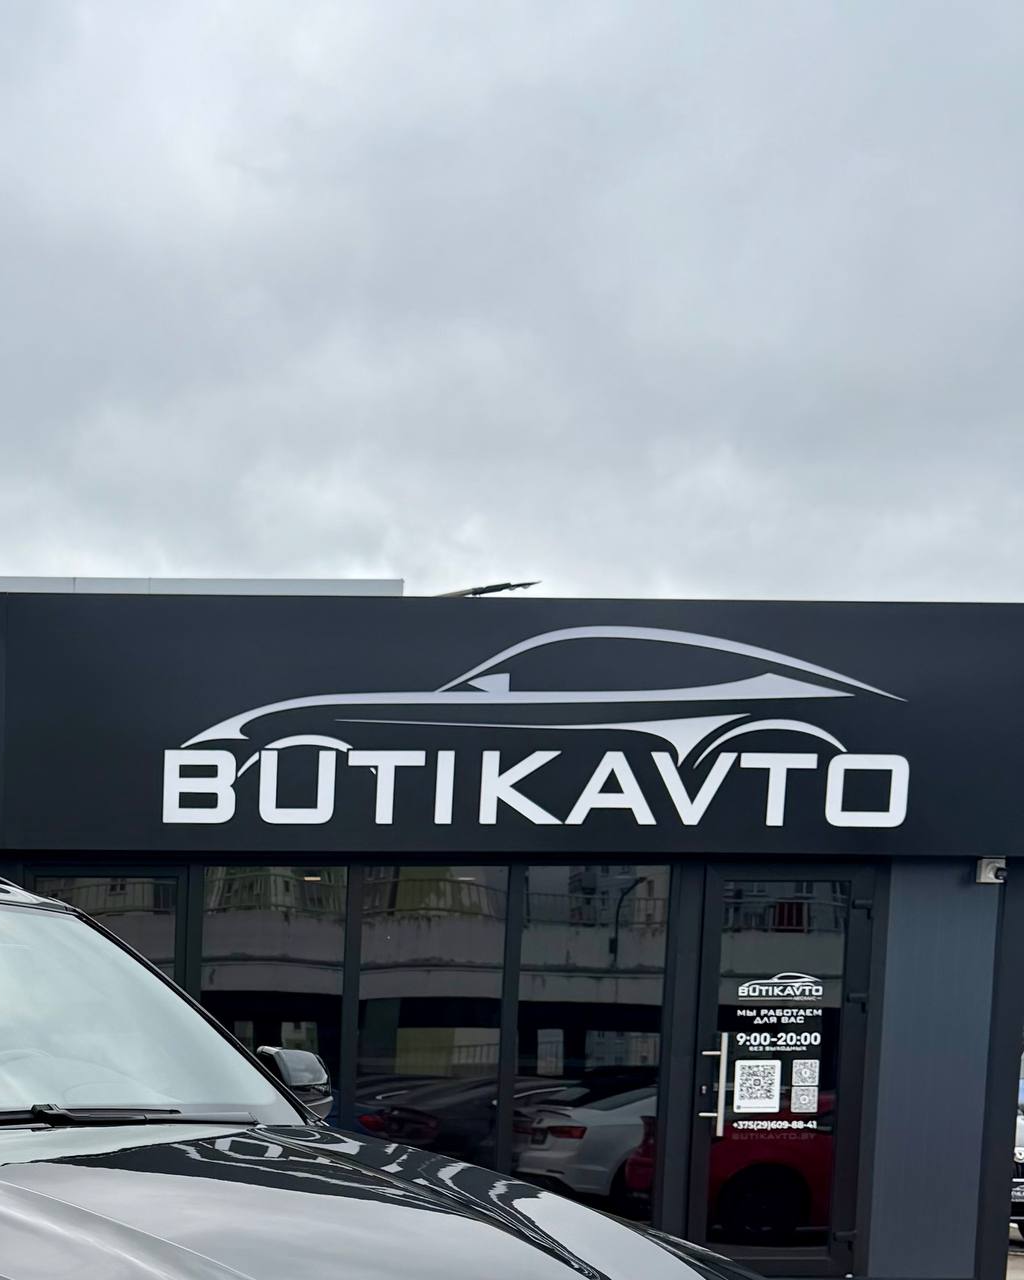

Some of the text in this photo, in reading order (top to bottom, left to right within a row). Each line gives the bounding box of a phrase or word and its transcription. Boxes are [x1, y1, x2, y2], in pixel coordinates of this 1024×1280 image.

[161, 747, 910, 829] BUTIKAVTO
[738, 985, 823, 997] BUTIKAVTO
[737, 1009, 823, 1017] МЫ РАБОТАЕМ
[753, 1016, 805, 1024] ДЛЯ ВАС
[736, 1032, 822, 1046] 9:00-20:00
